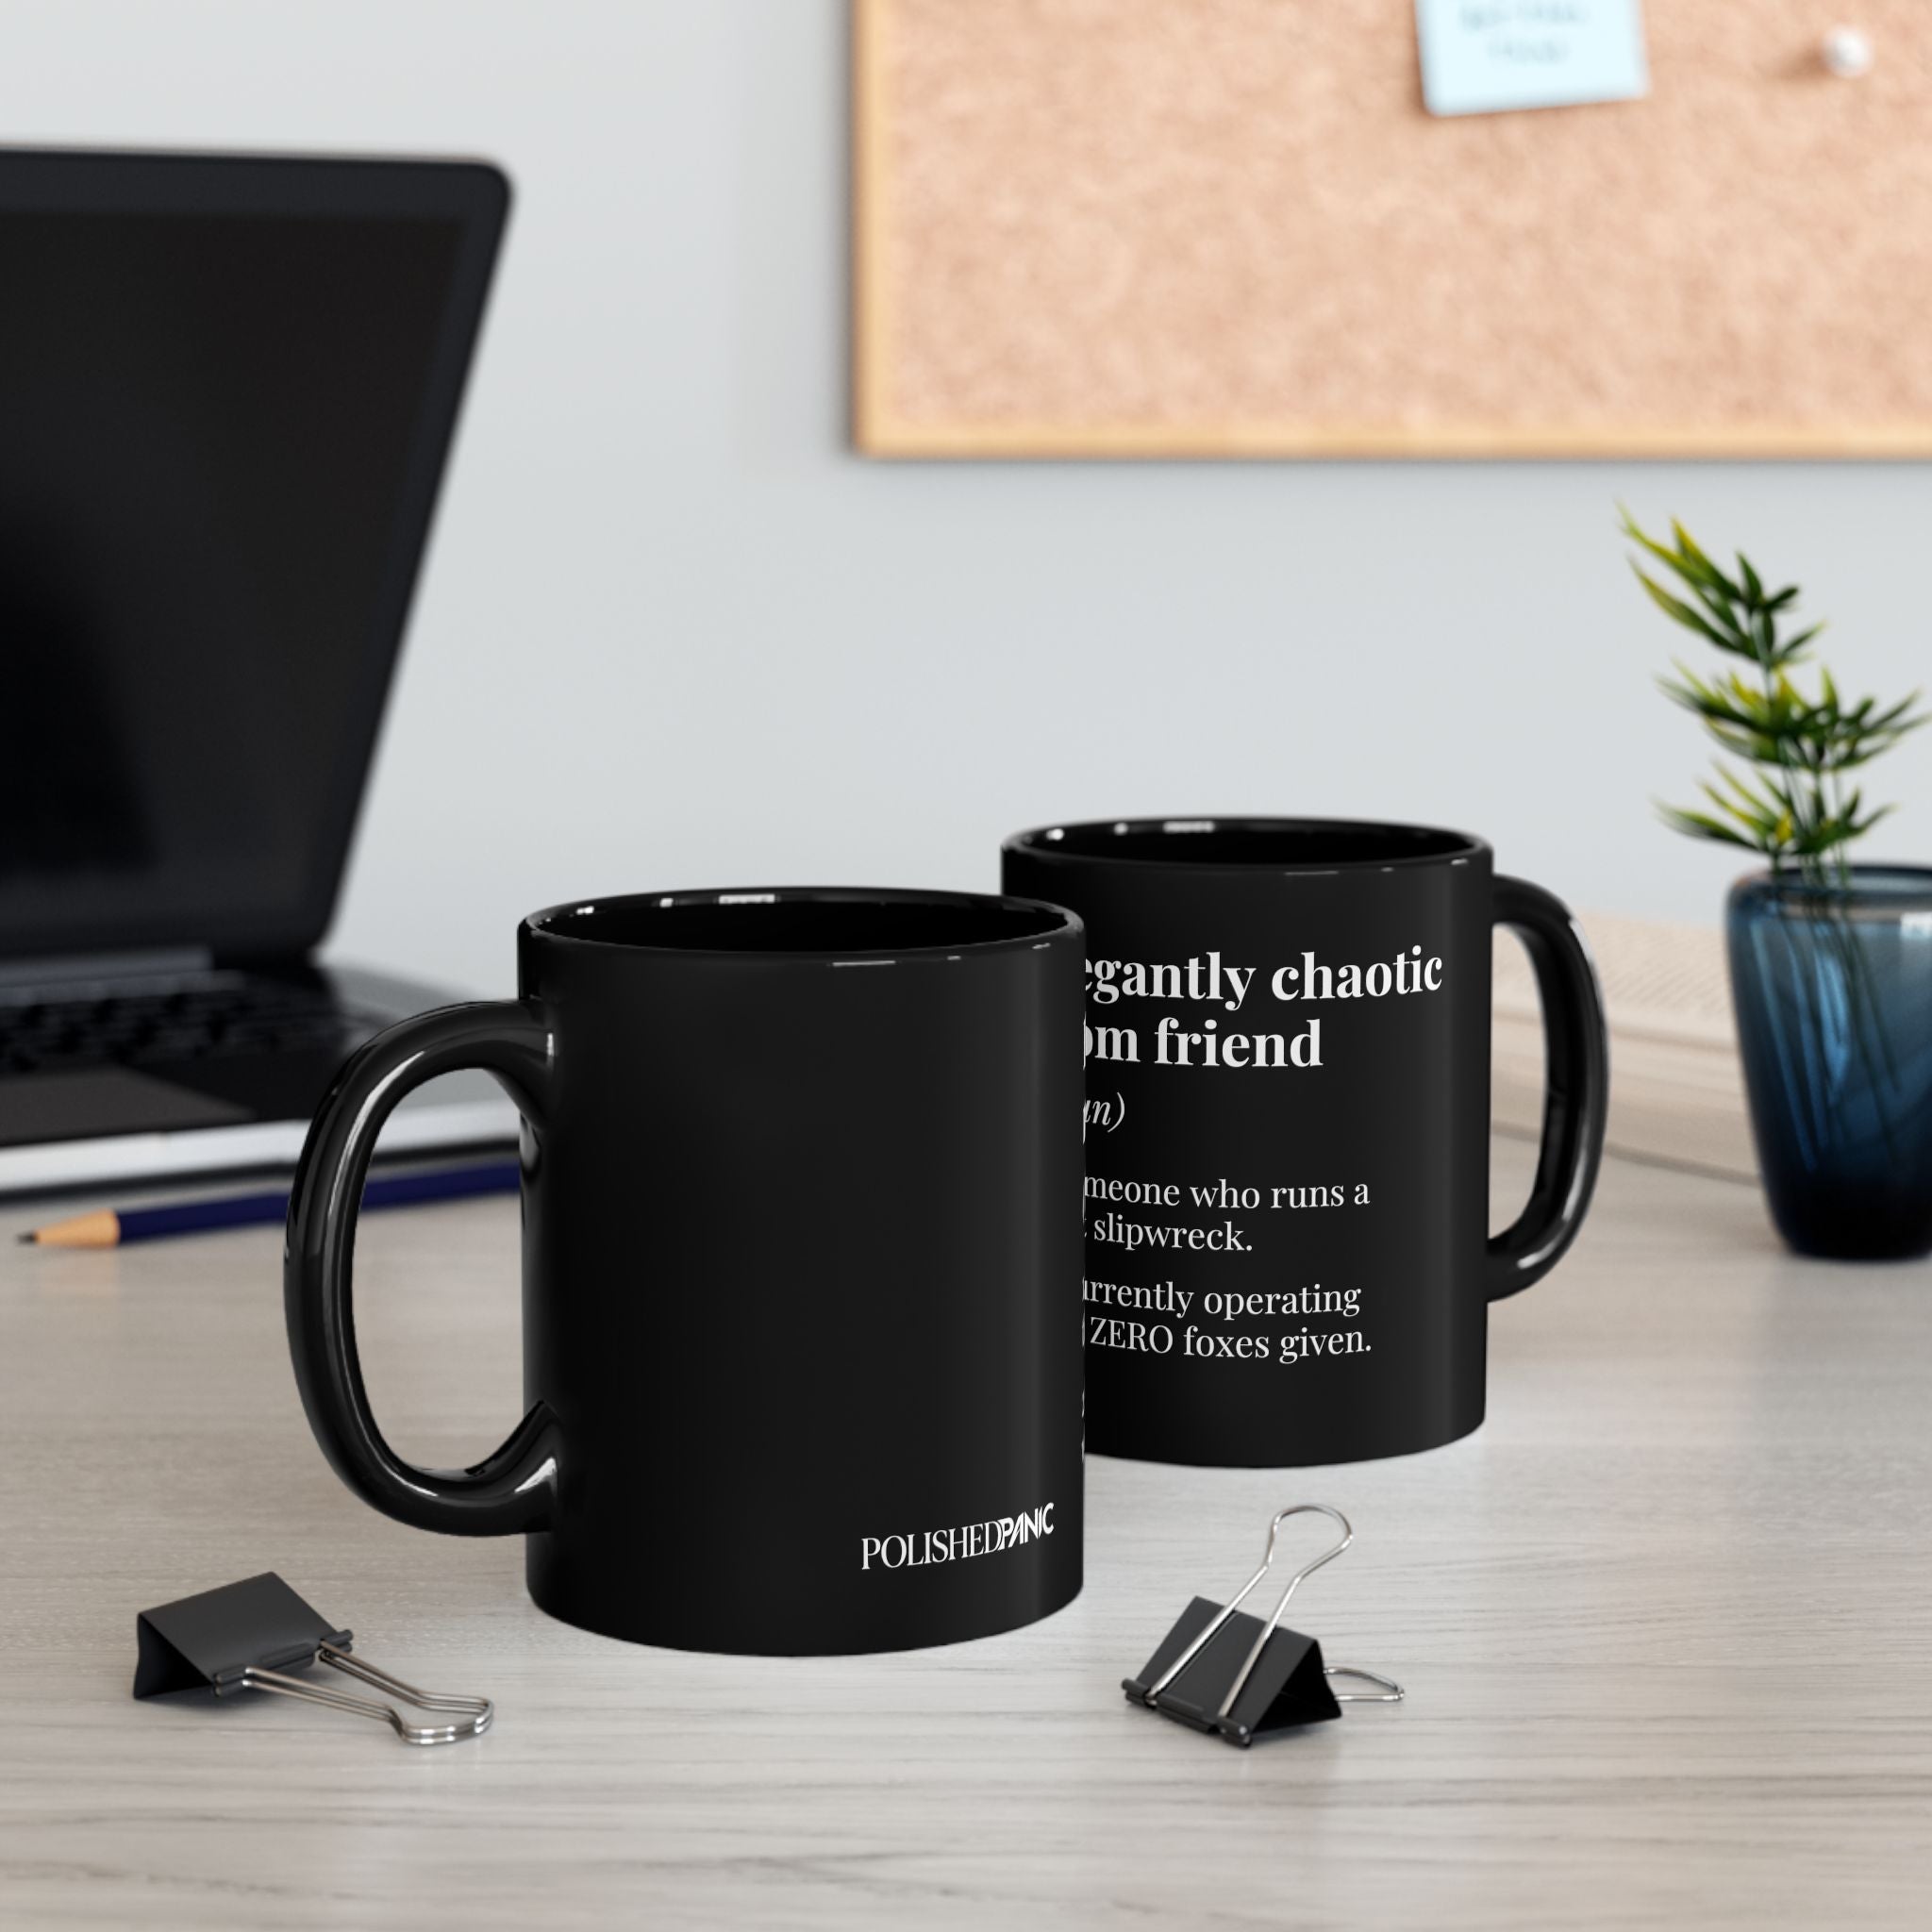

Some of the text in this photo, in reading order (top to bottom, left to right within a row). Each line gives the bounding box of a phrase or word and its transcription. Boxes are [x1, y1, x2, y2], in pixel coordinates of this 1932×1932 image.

[1272, 945, 1442, 1000] chaotic
[1155, 1017, 1324, 1067] friend
[1190, 1179, 1259, 1208] who
[1271, 1186, 1344, 1208] runs
[1355, 1184, 1370, 1205] a
[1094, 1213, 1252, 1251] slipwreck.
[1205, 1284, 1361, 1320] operating
[1091, 1317, 1371, 1364] ZERO foxes given.
